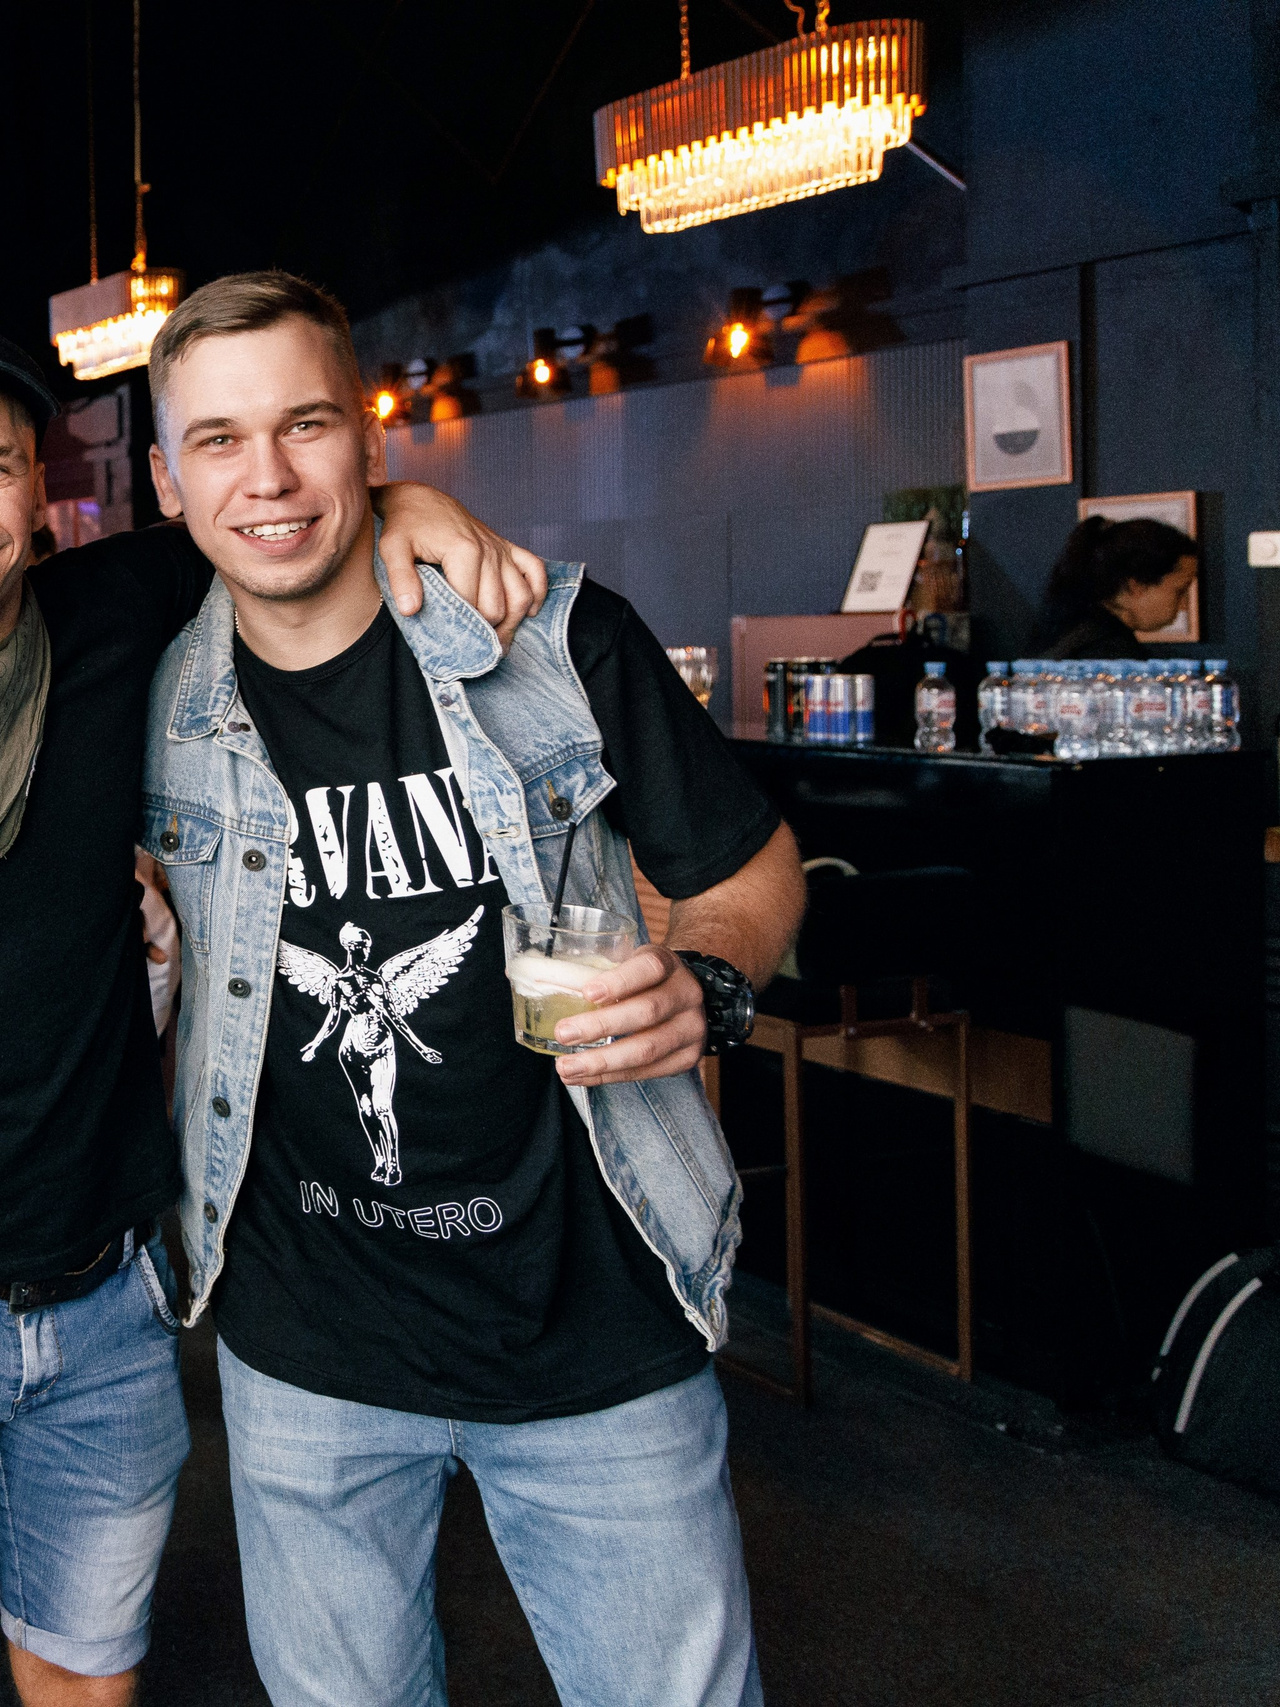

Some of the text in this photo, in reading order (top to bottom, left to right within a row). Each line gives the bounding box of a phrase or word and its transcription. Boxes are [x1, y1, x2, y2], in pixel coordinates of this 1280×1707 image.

[284, 767, 499, 908] VAN
[299, 1180, 503, 1239] IN UTERO
